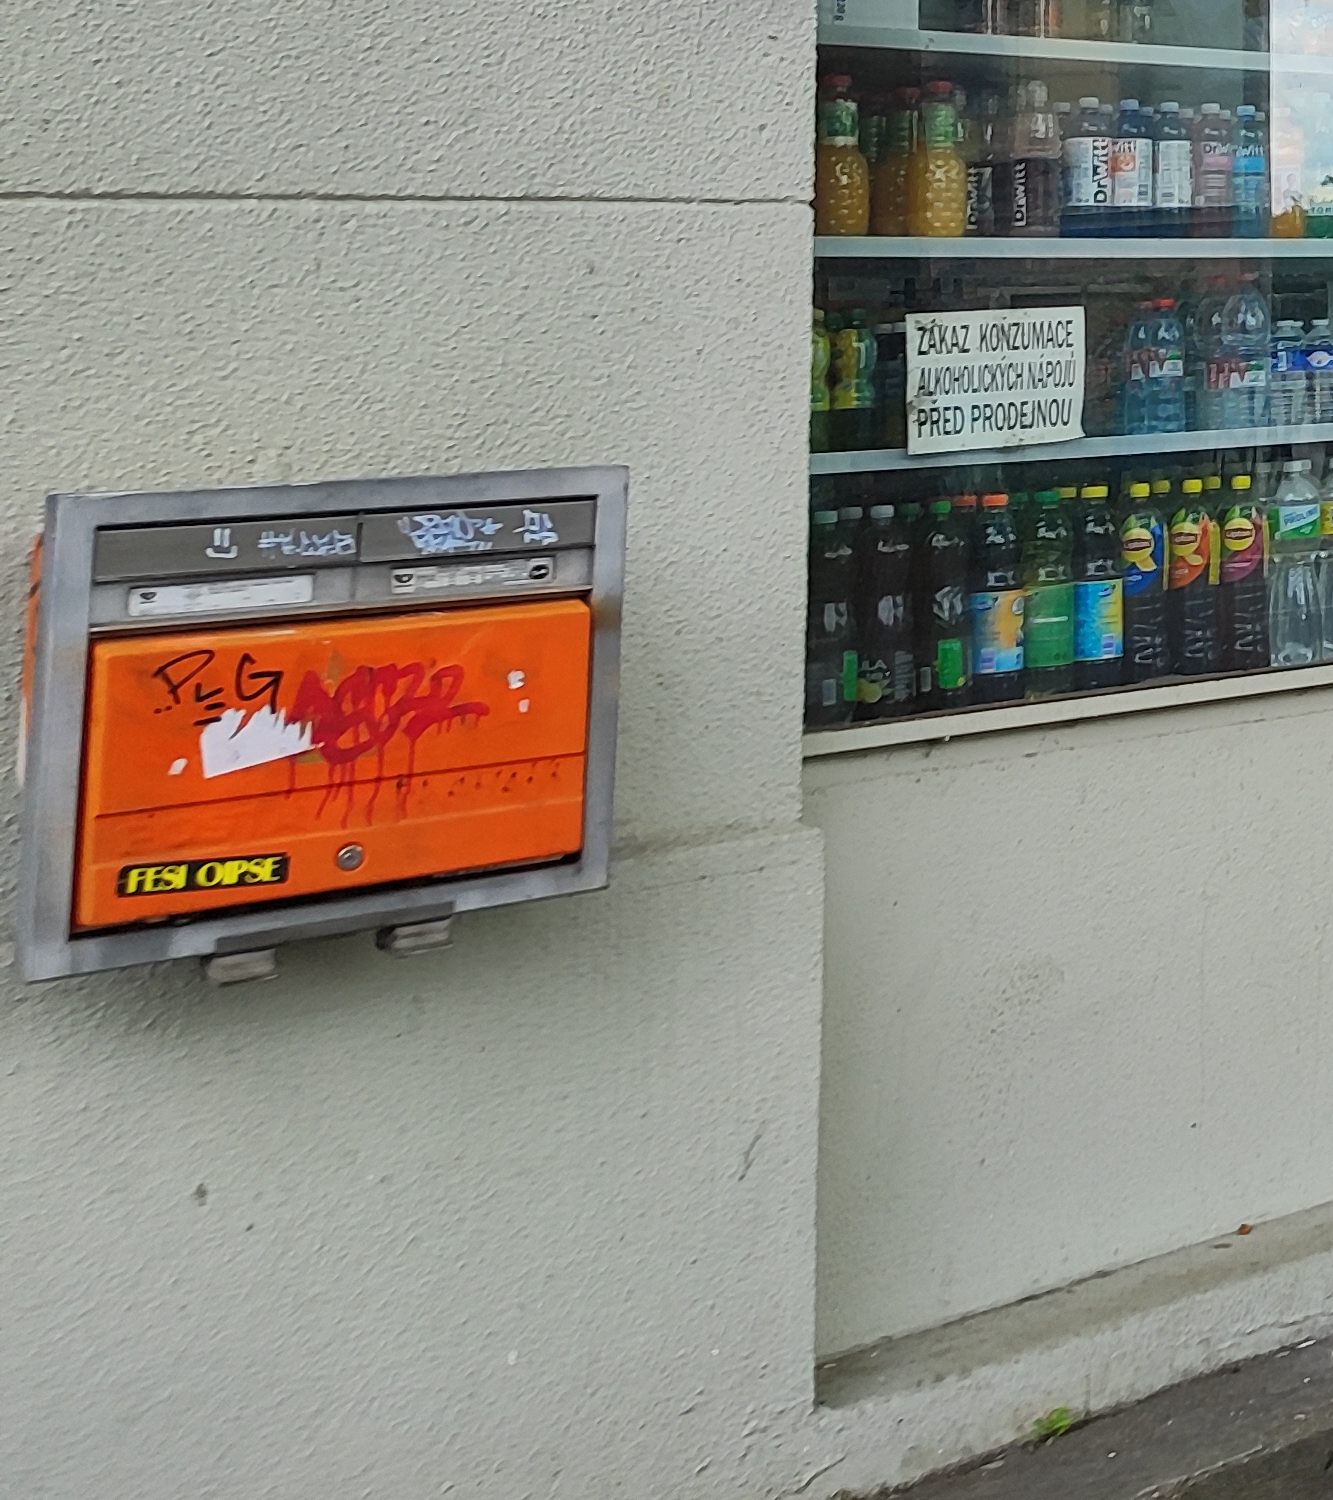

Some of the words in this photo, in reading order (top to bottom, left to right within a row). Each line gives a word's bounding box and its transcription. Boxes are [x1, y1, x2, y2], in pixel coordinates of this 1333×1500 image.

[917, 319, 970, 355] ZÁKAZ
[979, 320, 1074, 352] KONZUMACE
[916, 356, 1023, 397] ALKOHOLICKÝCH
[917, 399, 965, 438] PŘED
[971, 399, 1072, 433] PRODEJNOU
